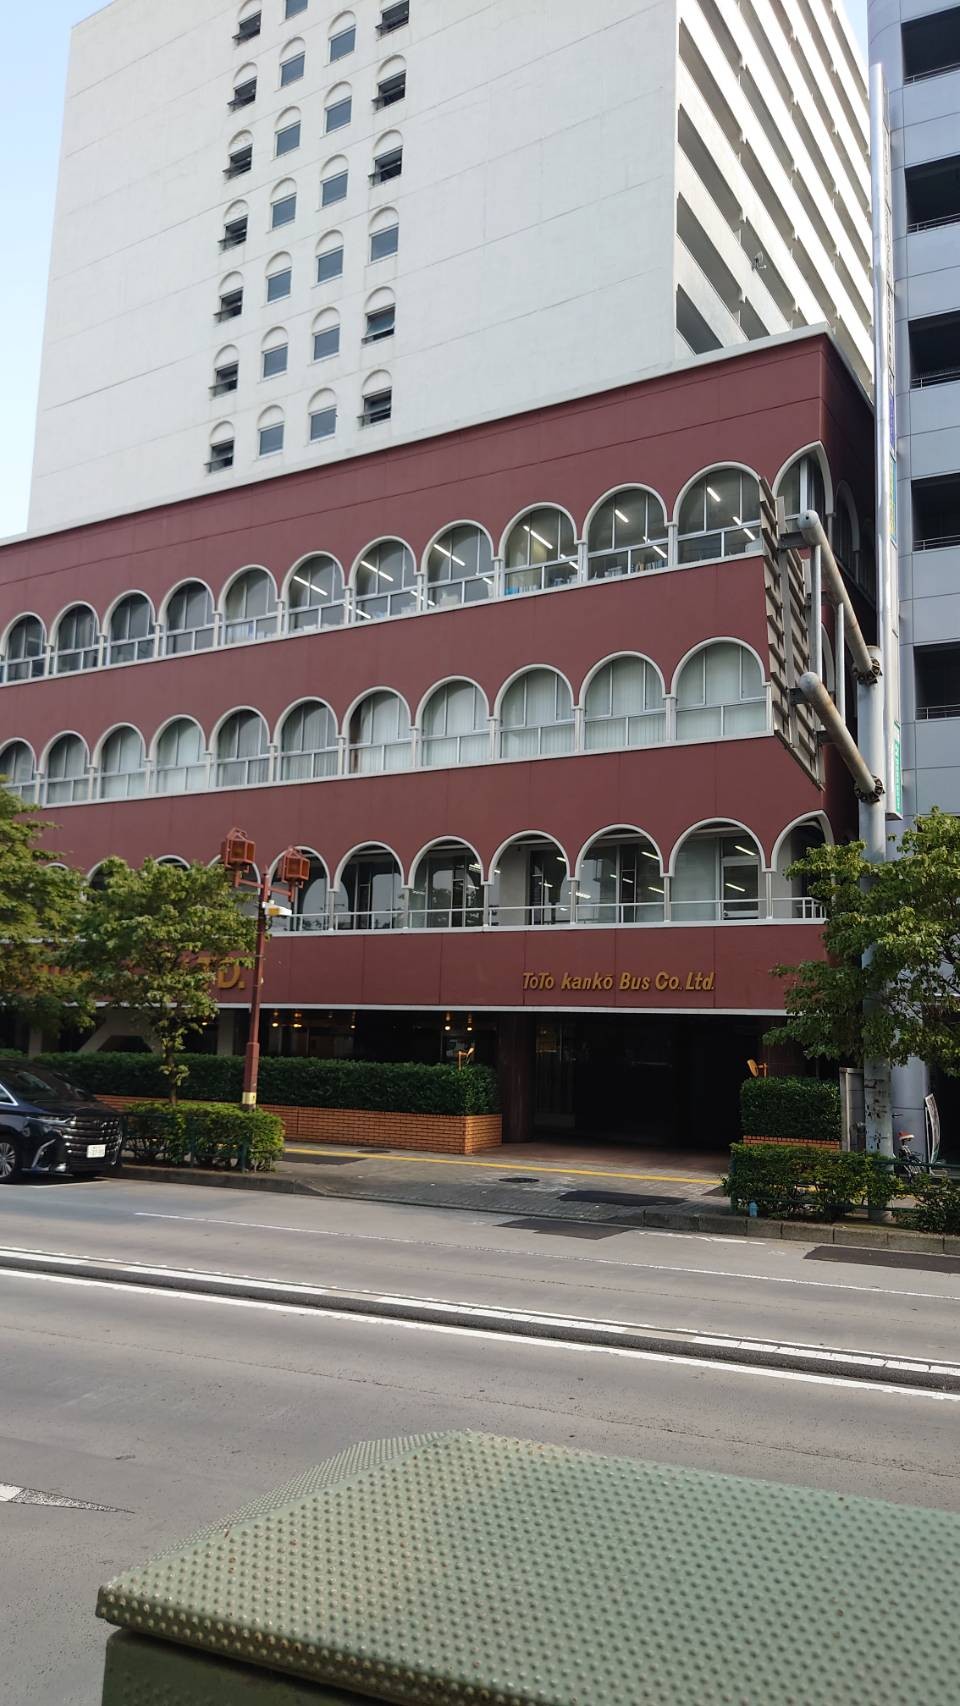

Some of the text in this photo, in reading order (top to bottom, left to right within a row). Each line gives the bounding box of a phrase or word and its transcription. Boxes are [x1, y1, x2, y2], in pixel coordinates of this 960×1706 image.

[523, 972, 555, 990] ToTo
[619, 972, 650, 990] Bus
[685, 971, 715, 990] Ltd.
